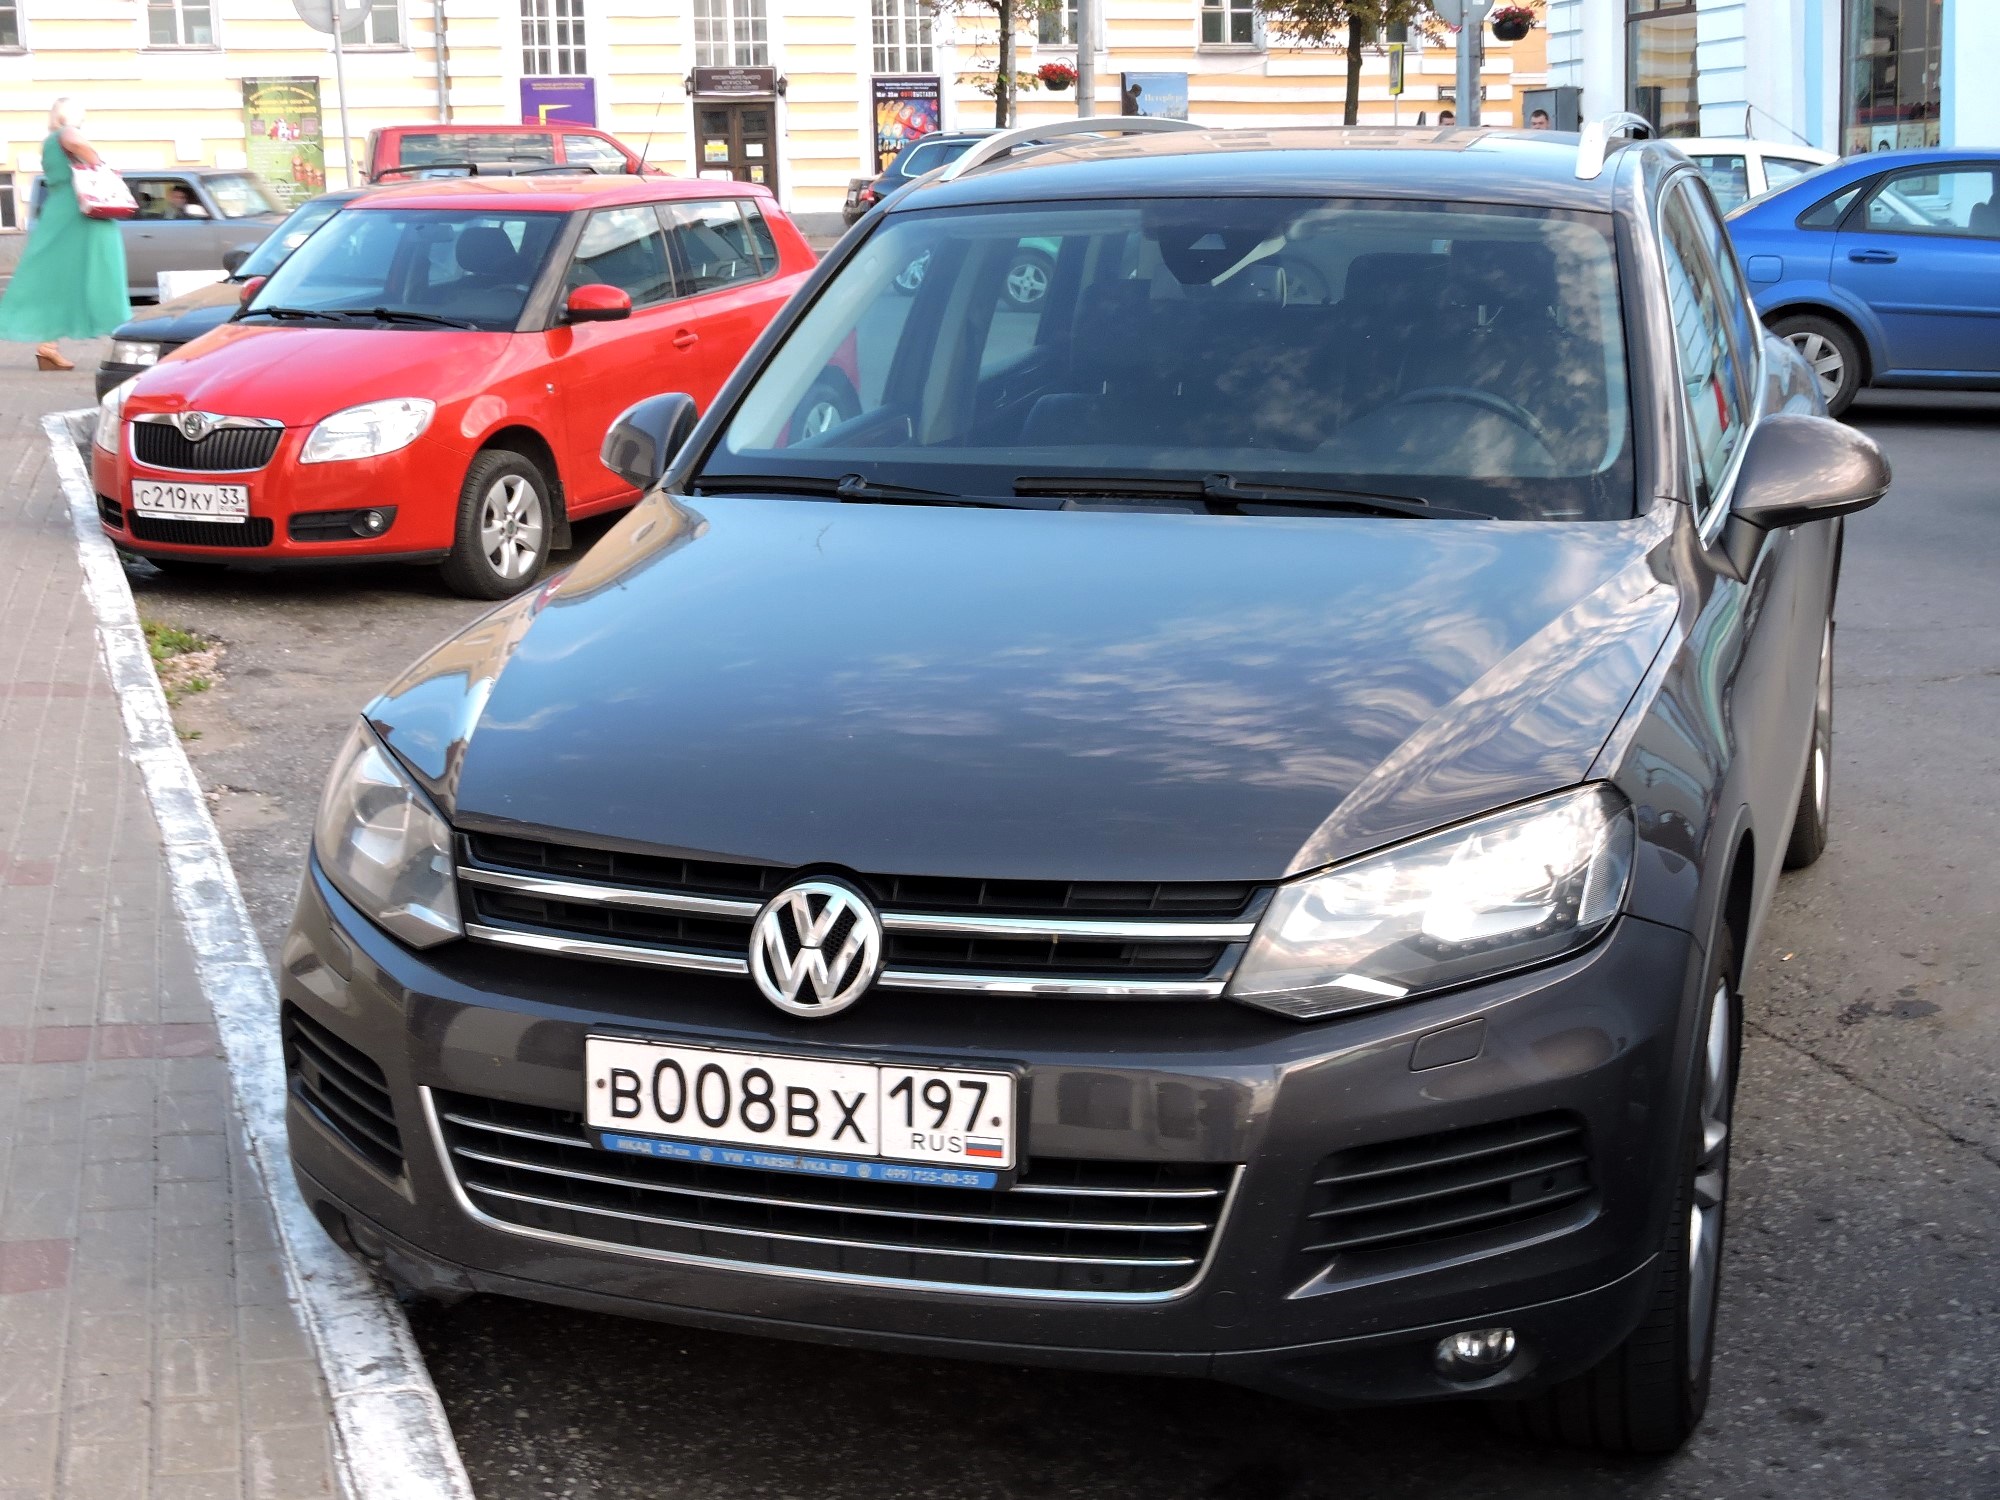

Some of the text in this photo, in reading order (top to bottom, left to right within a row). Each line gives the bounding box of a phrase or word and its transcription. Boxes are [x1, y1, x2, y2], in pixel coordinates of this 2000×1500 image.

[141, 486, 239, 510] С219КУ 33
[611, 1058, 989, 1144] В008ВХ 197
[911, 1132, 962, 1153] RUS
